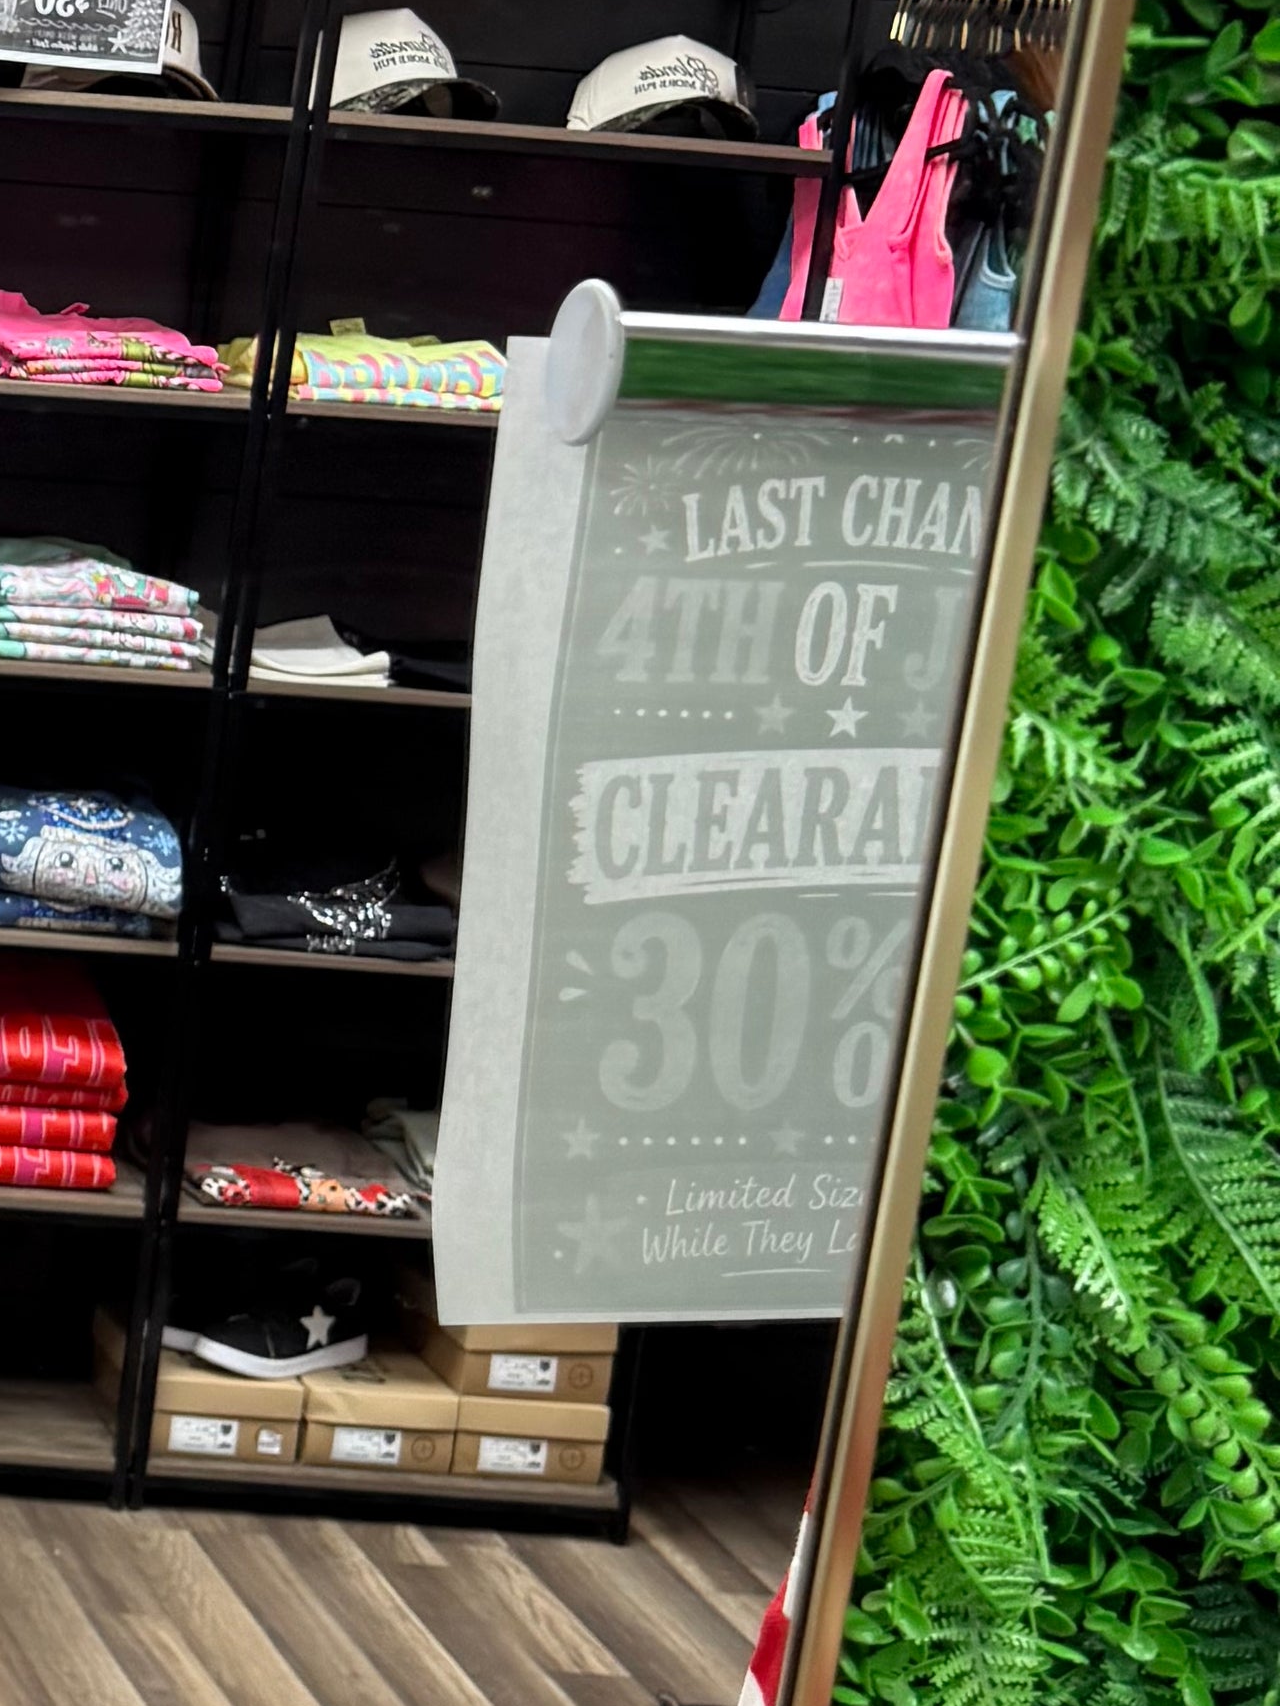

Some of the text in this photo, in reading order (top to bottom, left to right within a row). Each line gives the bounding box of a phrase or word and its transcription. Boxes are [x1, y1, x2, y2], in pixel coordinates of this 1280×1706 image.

[682, 475, 826, 562] LAST
[597, 575, 787, 686] 4TH
[794, 581, 898, 687] OF
[599, 912, 910, 1111] 30%
[665, 1173, 797, 1216] Limited
[642, 1222, 730, 1265] While
[741, 1219, 814, 1264] They
